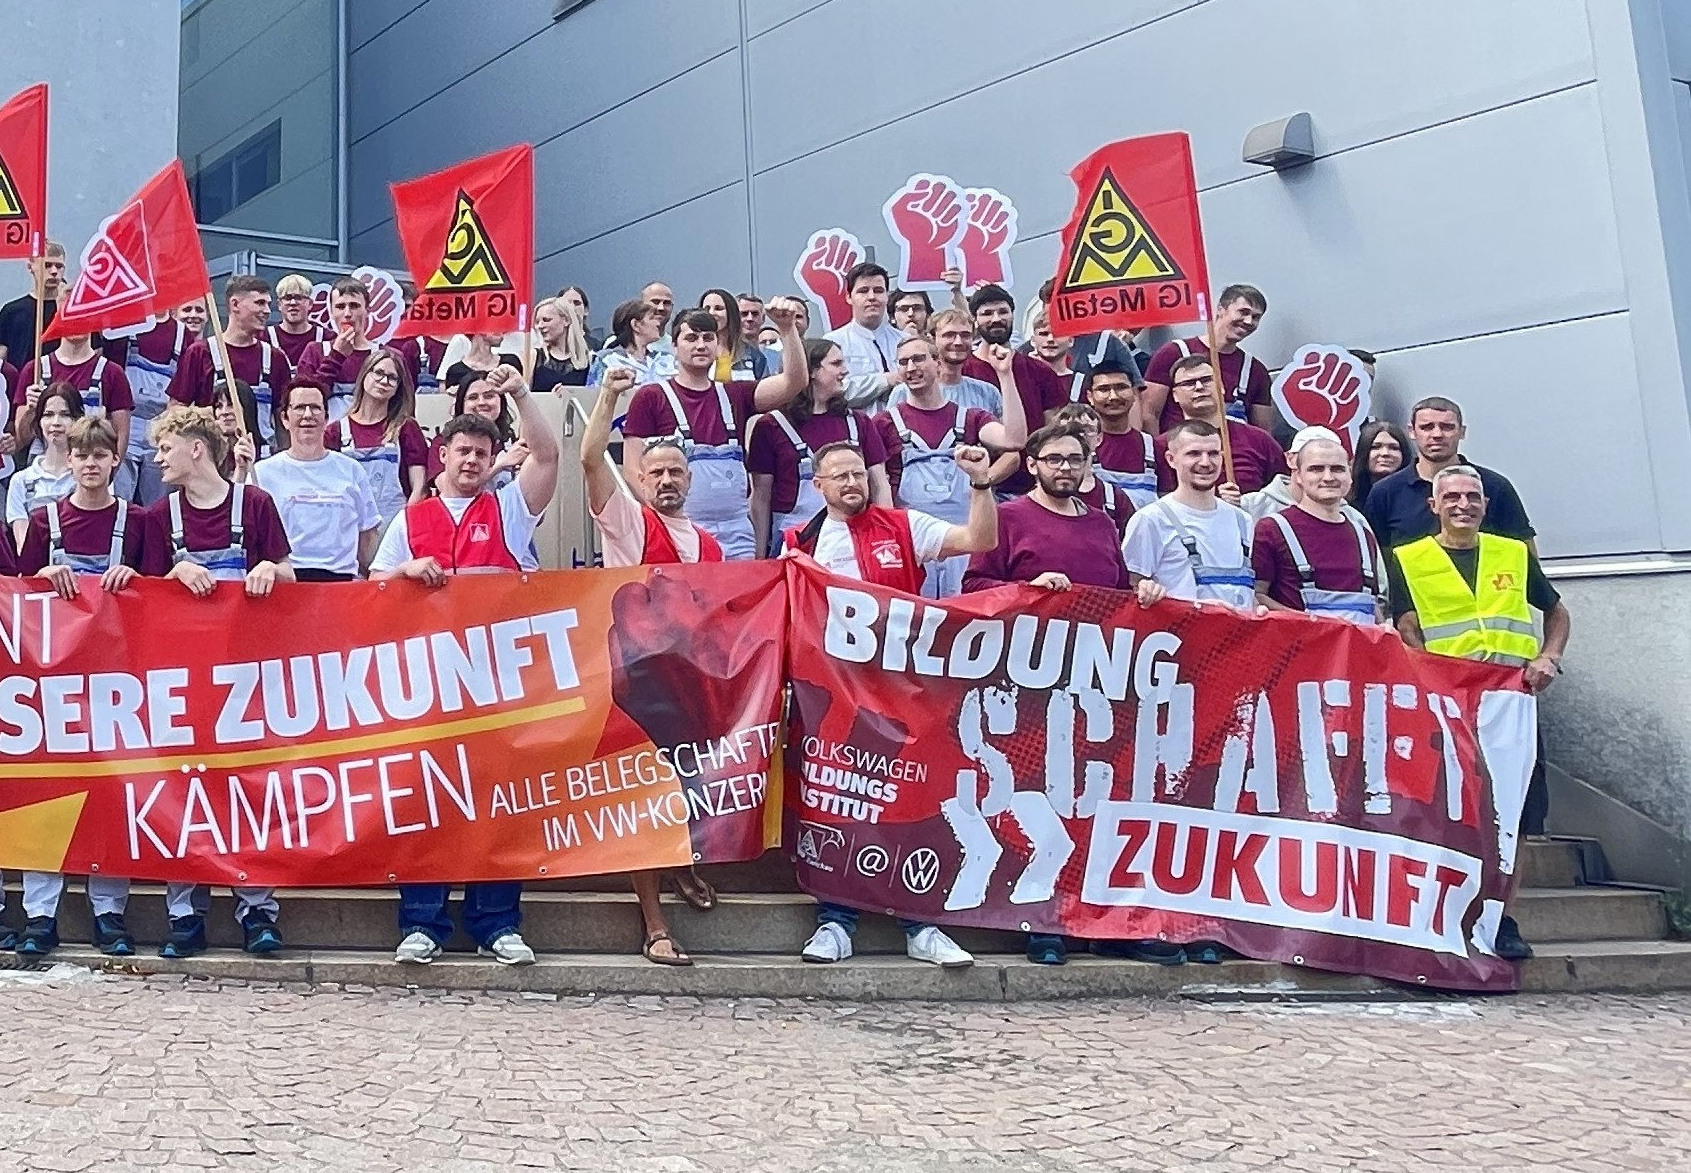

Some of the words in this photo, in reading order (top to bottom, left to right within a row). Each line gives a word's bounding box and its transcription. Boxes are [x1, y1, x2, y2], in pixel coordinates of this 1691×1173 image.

[211, 607, 581, 745] ZUKUNFT
[823, 585, 1184, 705] BILDUNG
[124, 742, 477, 862] KÄMPFEN
[490, 771, 561, 819] ALLE
[543, 813, 581, 851] IM
[584, 772, 767, 842] VW-KONZER
[800, 780, 885, 825] STITUT
[801, 757, 899, 803] ILDUNGS
[902, 847, 941, 894] VW
[1108, 818, 1469, 937] ZUKUNFT
